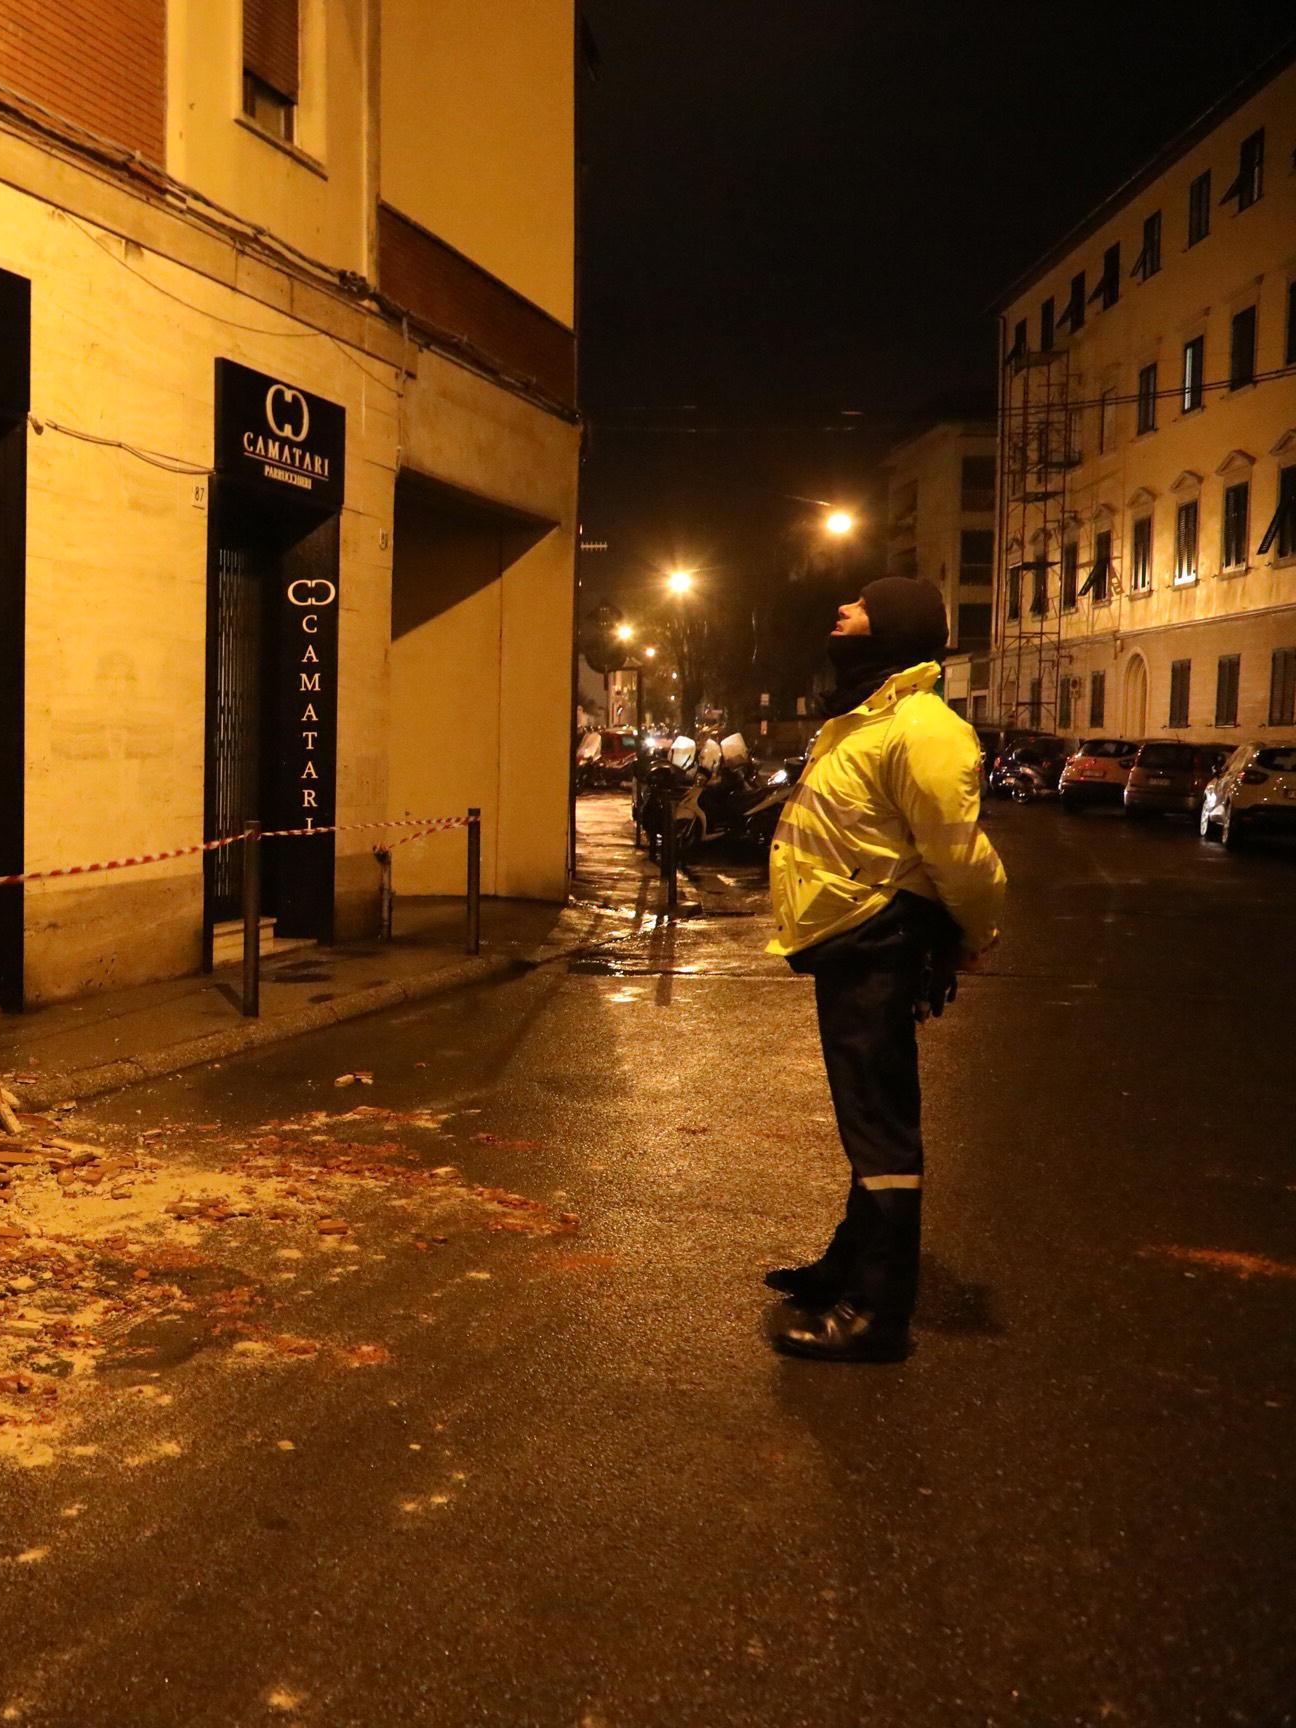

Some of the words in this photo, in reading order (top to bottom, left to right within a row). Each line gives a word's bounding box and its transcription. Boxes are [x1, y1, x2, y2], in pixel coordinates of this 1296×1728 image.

[242, 431, 330, 476] CAMATARI
[194, 486, 205, 502] 87
[299, 614, 321, 836] CAMATARI
